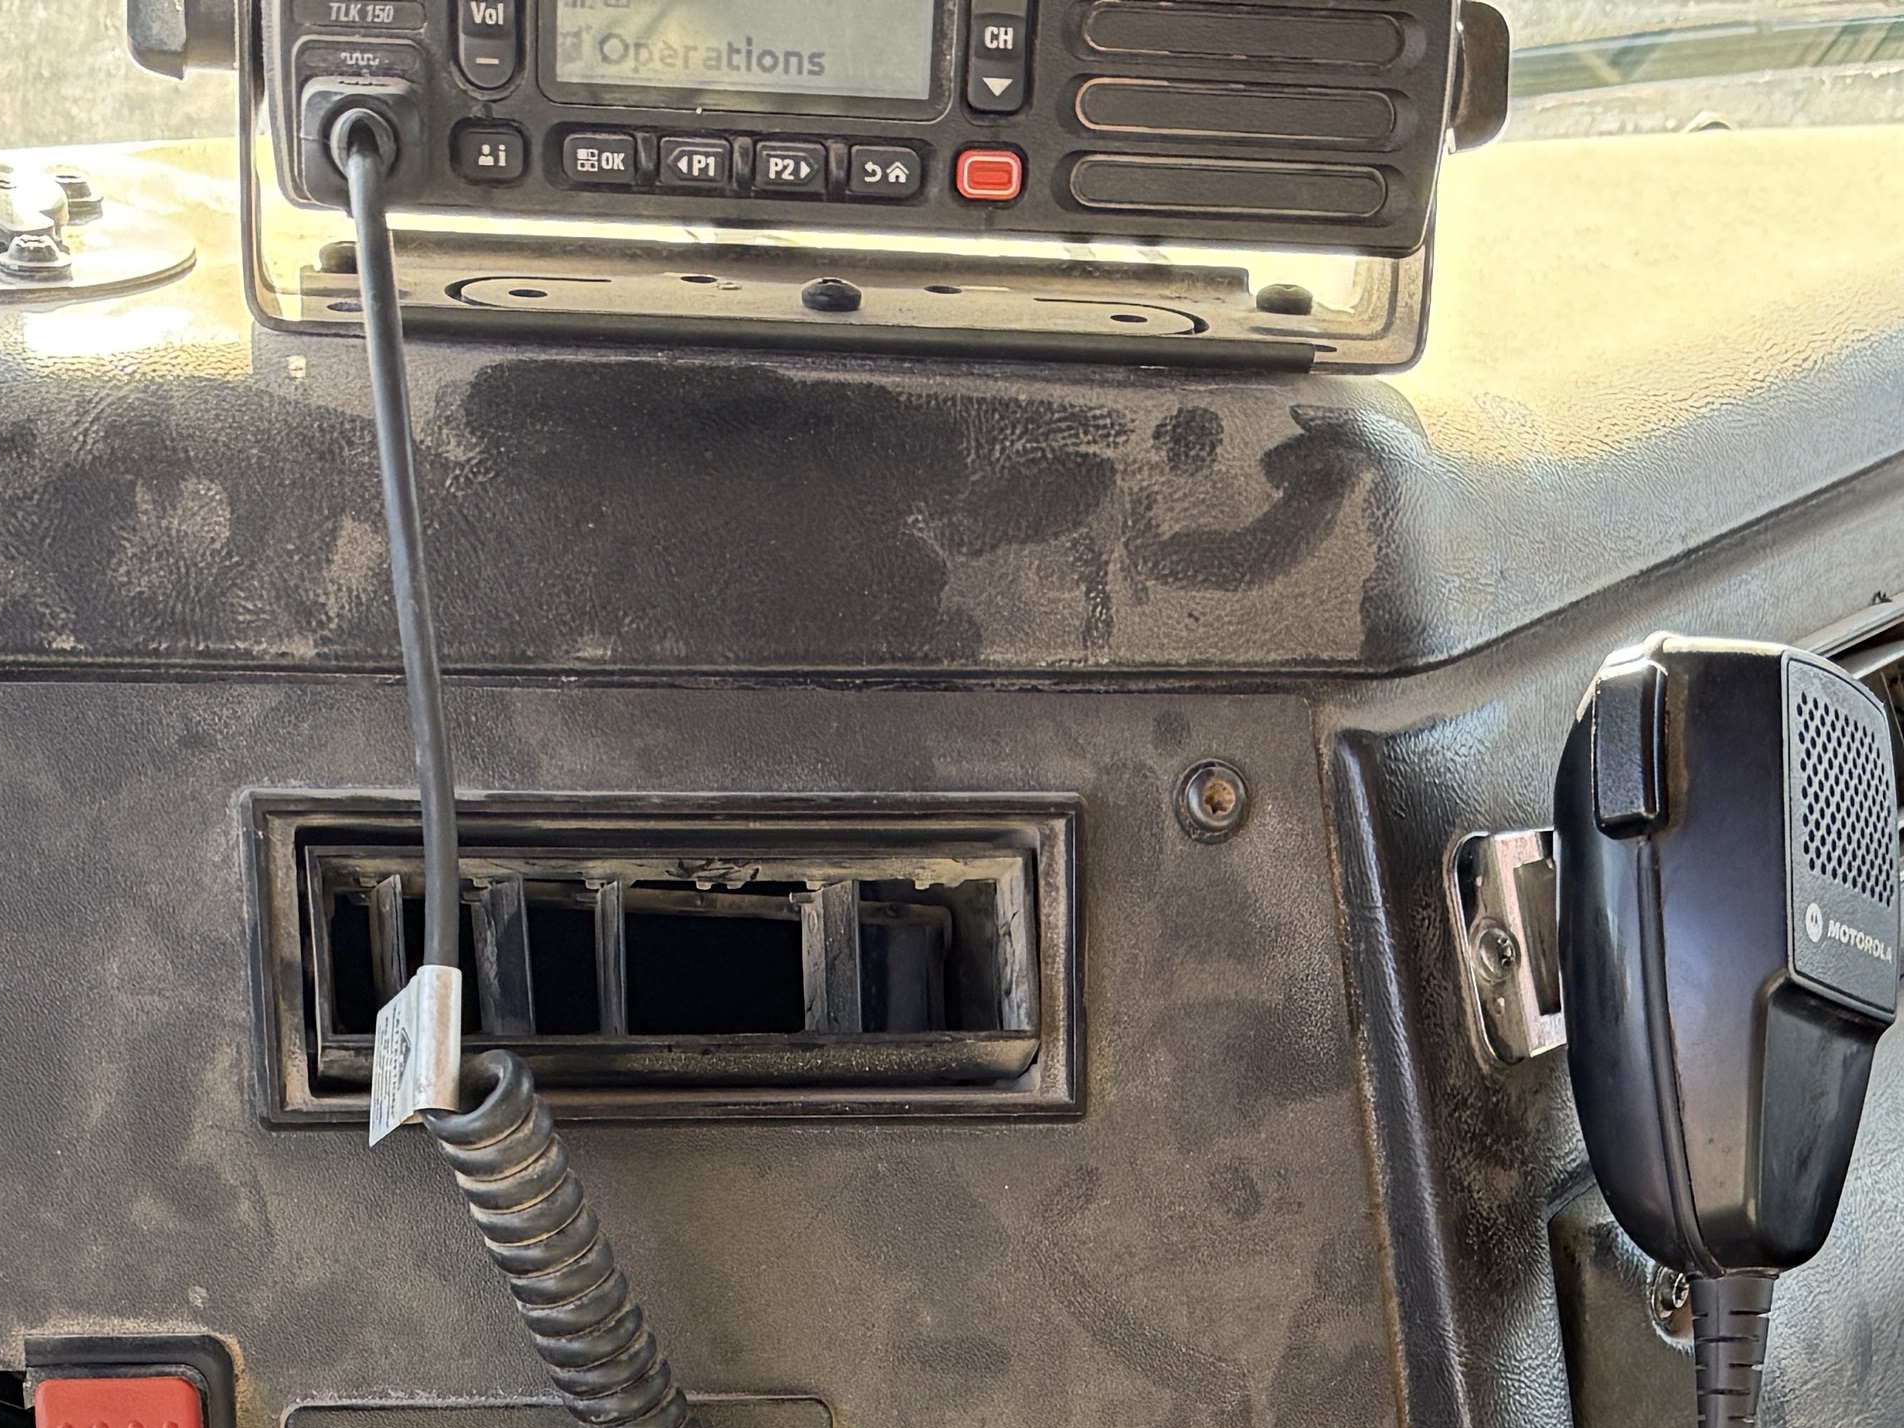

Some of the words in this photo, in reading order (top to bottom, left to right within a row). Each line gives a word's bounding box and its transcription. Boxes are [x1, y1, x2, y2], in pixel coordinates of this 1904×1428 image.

[329, 3, 362, 22] TLK
[366, 4, 394, 24] 150
[471, 1, 504, 26] Vol
[984, 26, 1013, 50] CH
[598, 32, 826, 77] Operations
[601, 152, 625, 171] OK
[692, 157, 715, 177] P1
[768, 159, 794, 181] P2
[1827, 919, 1893, 964] MOTOROLA
